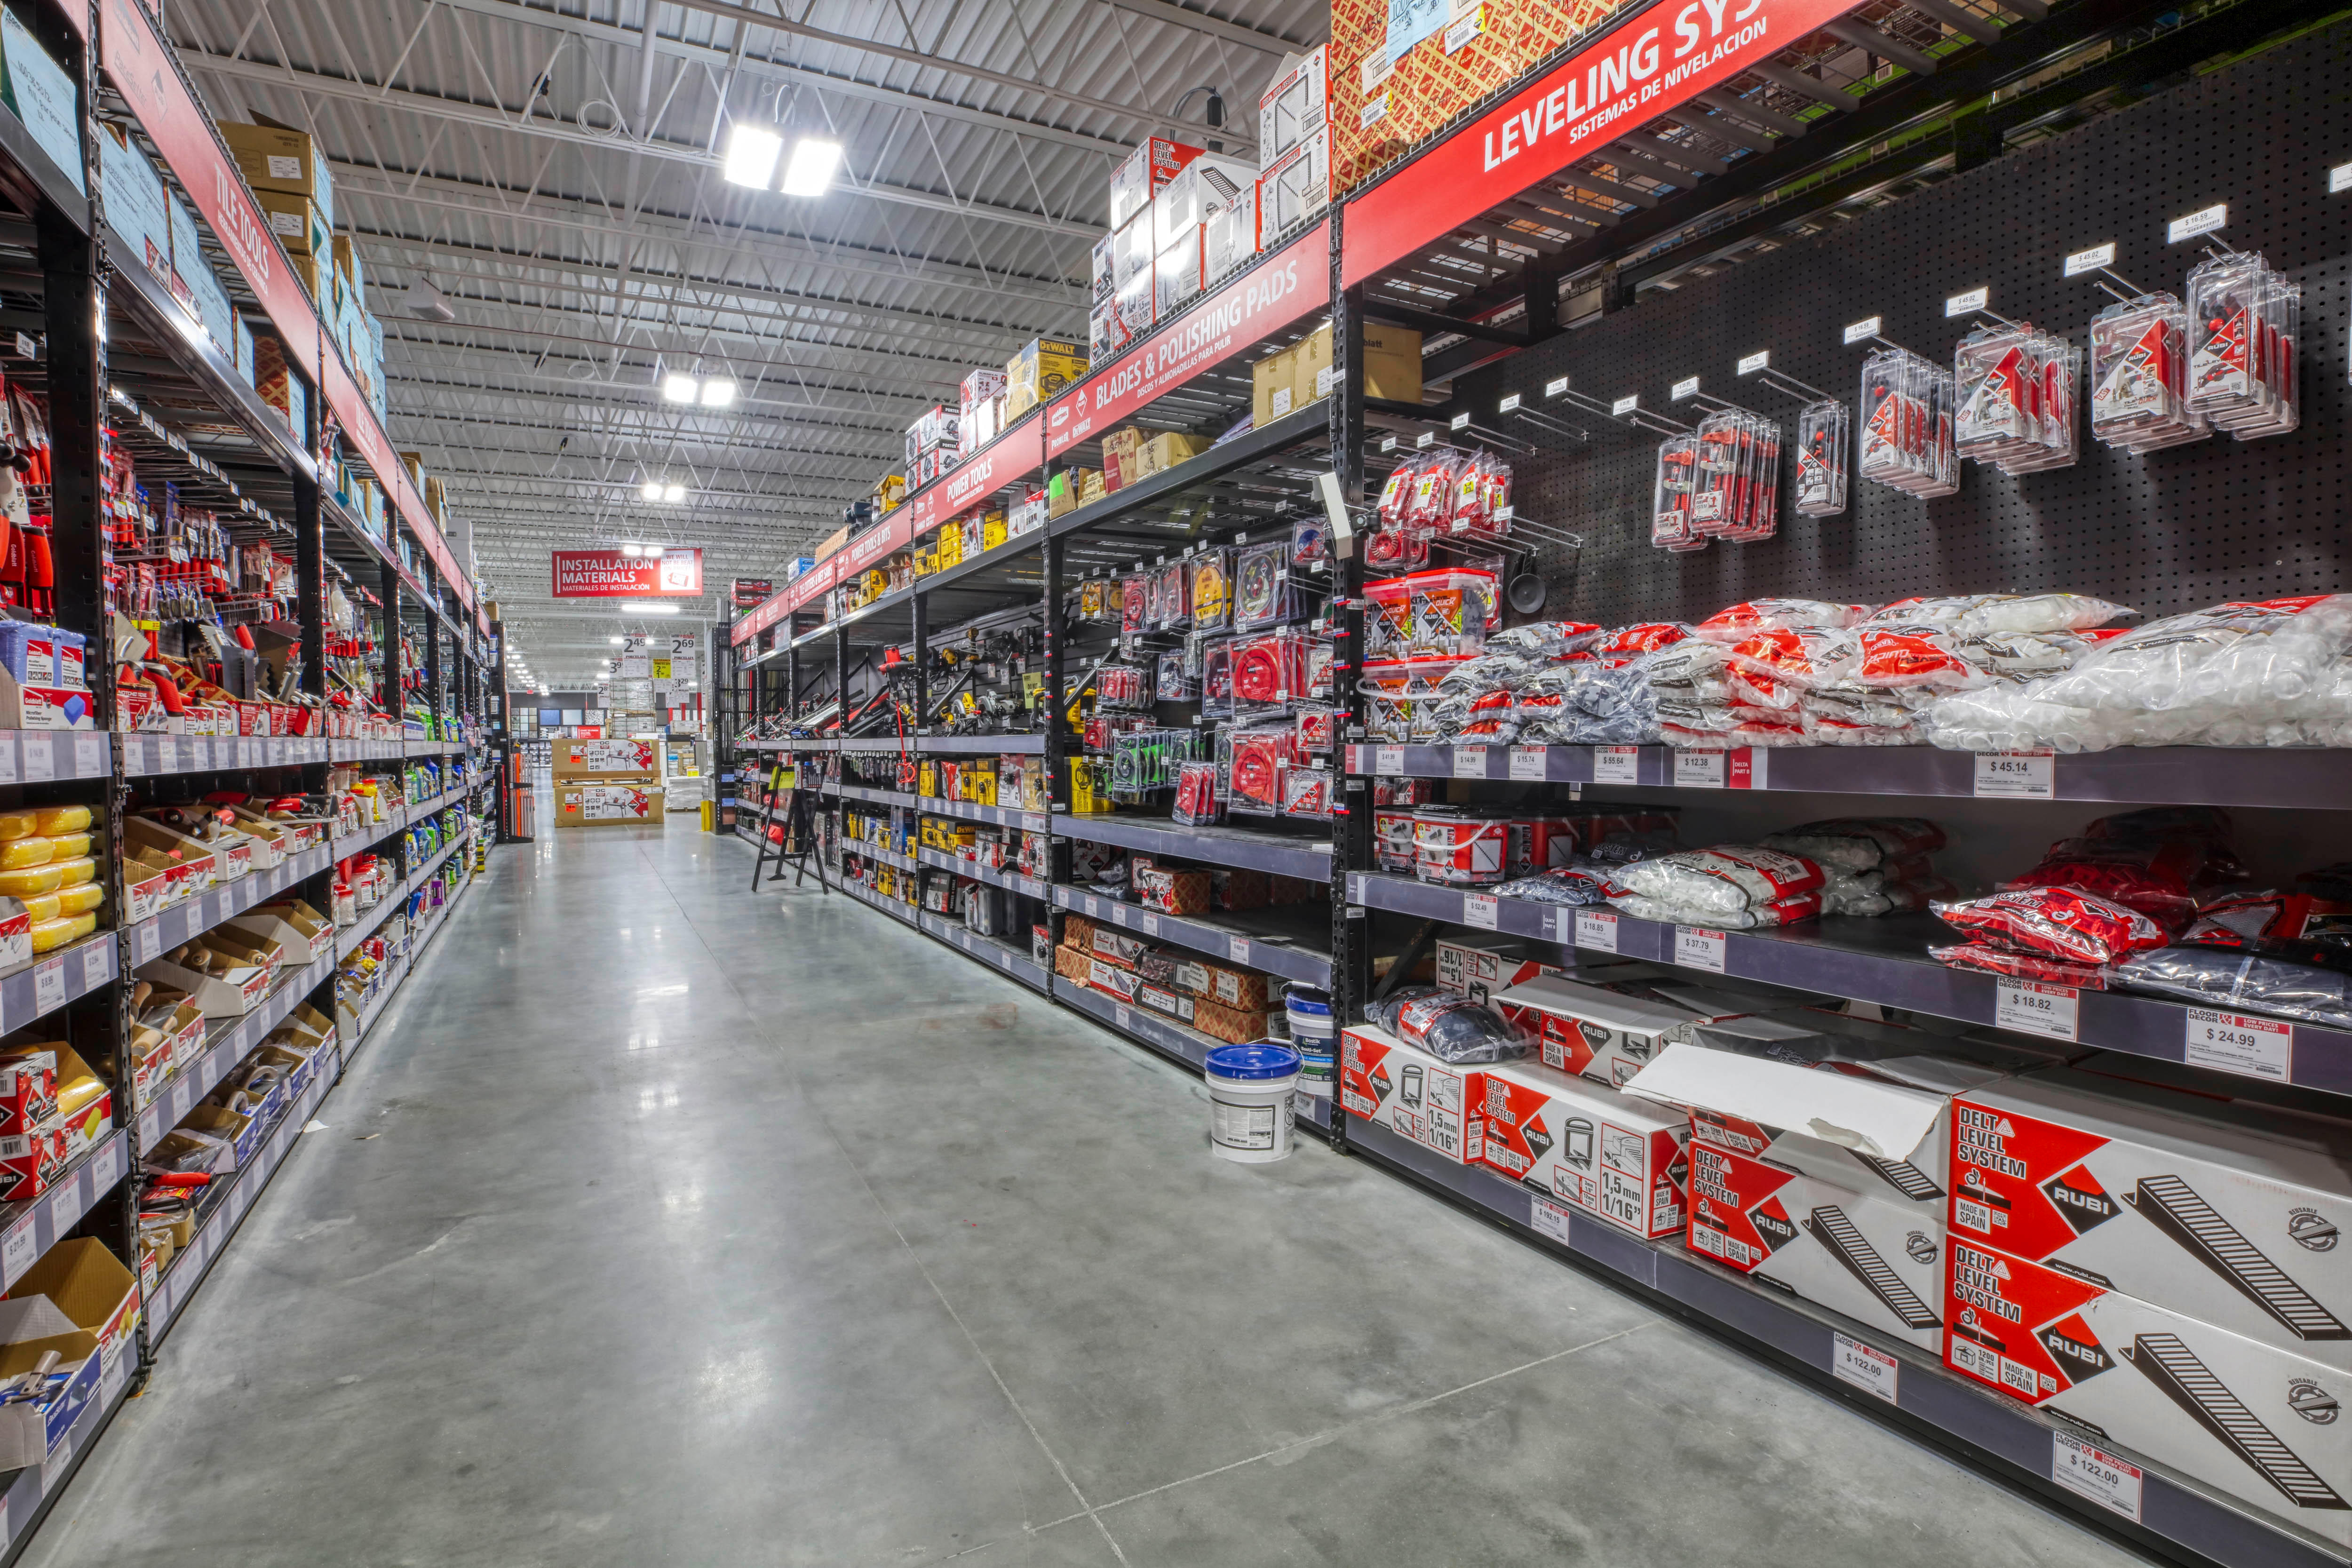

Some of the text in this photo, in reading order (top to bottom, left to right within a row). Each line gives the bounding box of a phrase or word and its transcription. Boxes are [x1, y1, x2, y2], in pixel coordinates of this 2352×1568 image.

[1461, 52, 1474, 64] RUBI
[1569, 16, 1767, 145] SISTEMAS DE NIVELACION
[1485, 27, 1659, 172] LEVELING
[1154, 150, 1172, 160] LEVEL
[1154, 158, 1180, 170] SYSTEM
[215, 162, 237, 230] TILE
[239, 202, 269, 279] TOOLS
[2192, 212, 2208, 223] 16.59
[2084, 251, 2098, 260] 45.02
[1963, 295, 1975, 303] 45.02
[1097, 259, 1297, 410] BLADES & POLISHING PADS
[2208, 342, 2228, 351] RUBI
[2128, 353, 2146, 361] RUBI
[1137, 335, 1231, 398] DISCOS Y ALMOHADILLAS PARA PULIR
[2114, 412, 2148, 422] www.rubi.com
[1051, 432, 1069, 451] PROWLER
[947, 458, 992, 502] POWER TOOLS
[851, 543, 864, 563] POWER
[865, 534, 877, 554] TOOLS
[877, 532, 881, 546] &
[882, 525, 890, 544] BITS
[562, 558, 653, 571] INSTALLATION
[562, 571, 636, 583] MATERIALS
[1436, 597, 1456, 606] QUICK
[1999, 762, 2028, 773] 45.14
[1475, 903, 1487, 911] 52.49
[1589, 923, 1604, 931] 18.85
[1691, 940, 1708, 949] 37.79
[1998, 978, 2021, 986] FLOOR
[2022, 996, 2051, 1010] 18.82
[2189, 1009, 2218, 1019] FLOOR
[2189, 1014, 2218, 1024] DECOR
[2257, 1019, 2279, 1028] PRICES
[1584, 1025, 1607, 1040] RUBI
[2218, 1030, 2255, 1047] 24.99
[1343, 1045, 1358, 1059] LEVEL
[1546, 1043, 1555, 1053] MADE
[1343, 1056, 1364, 1074] SYSTEM
[1545, 1052, 1561, 1066] SPAIN
[1372, 1078, 1390, 1090] RUBI
[28, 1100, 41, 1112] RUBI
[1486, 1091, 1506, 1108] LEVEL
[1429, 1109, 1457, 1134] 1,5 mm
[1486, 1104, 1515, 1125] SYSTEM
[1526, 1130, 1549, 1146] RUBI
[1959, 1125, 2005, 1155] LEVEL
[40, 1161, 52, 1173] RUBI
[1508, 1157, 1520, 1171] SPAIN
[1958, 1144, 2026, 1179] SYSTEM
[1695, 1165, 1725, 1188] LEVEL
[1602, 1172, 1640, 1202] 1,5 mm
[1694, 1181, 1738, 1208] SYSTEM
[1656, 1197, 1669, 1206] SPAIN
[2054, 1188, 2108, 1216] RUBI
[1544, 1210, 1560, 1224] 192.15
[1960, 1202, 1986, 1217] MADE IN
[2288, 1207, 2318, 1217] REUSABLE
[1756, 1213, 1791, 1237] RUBI
[1960, 1211, 1986, 1231] SPAIN
[1710, 1231, 1722, 1239] 1200
[1728, 1239, 1738, 1250] MADE
[1728, 1247, 1747, 1263] SPAIN
[1955, 1264, 2001, 1297] LEVEL
[2055, 1262, 2106, 1285] www.rubi.com
[1758, 1275, 1792, 1292] www.rubi.com
[1955, 1282, 2021, 1324] SYSTEM
[1978, 1348, 1994, 1361] 1200
[2049, 1335, 2104, 1368] RUBI
[1854, 1357, 1881, 1376] 122.00
[2005, 1362, 2033, 1381] MADE IN
[2005, 1372, 2033, 1393] SPAIN
[2288, 1377, 2318, 1386] REUSABLE
[2050, 1410, 2103, 1435] www.rubi.com
[2056, 1433, 2081, 1449] FLOOR
[2056, 1439, 2081, 1454] DECOR
[2082, 1459, 2119, 1486] 122.00
